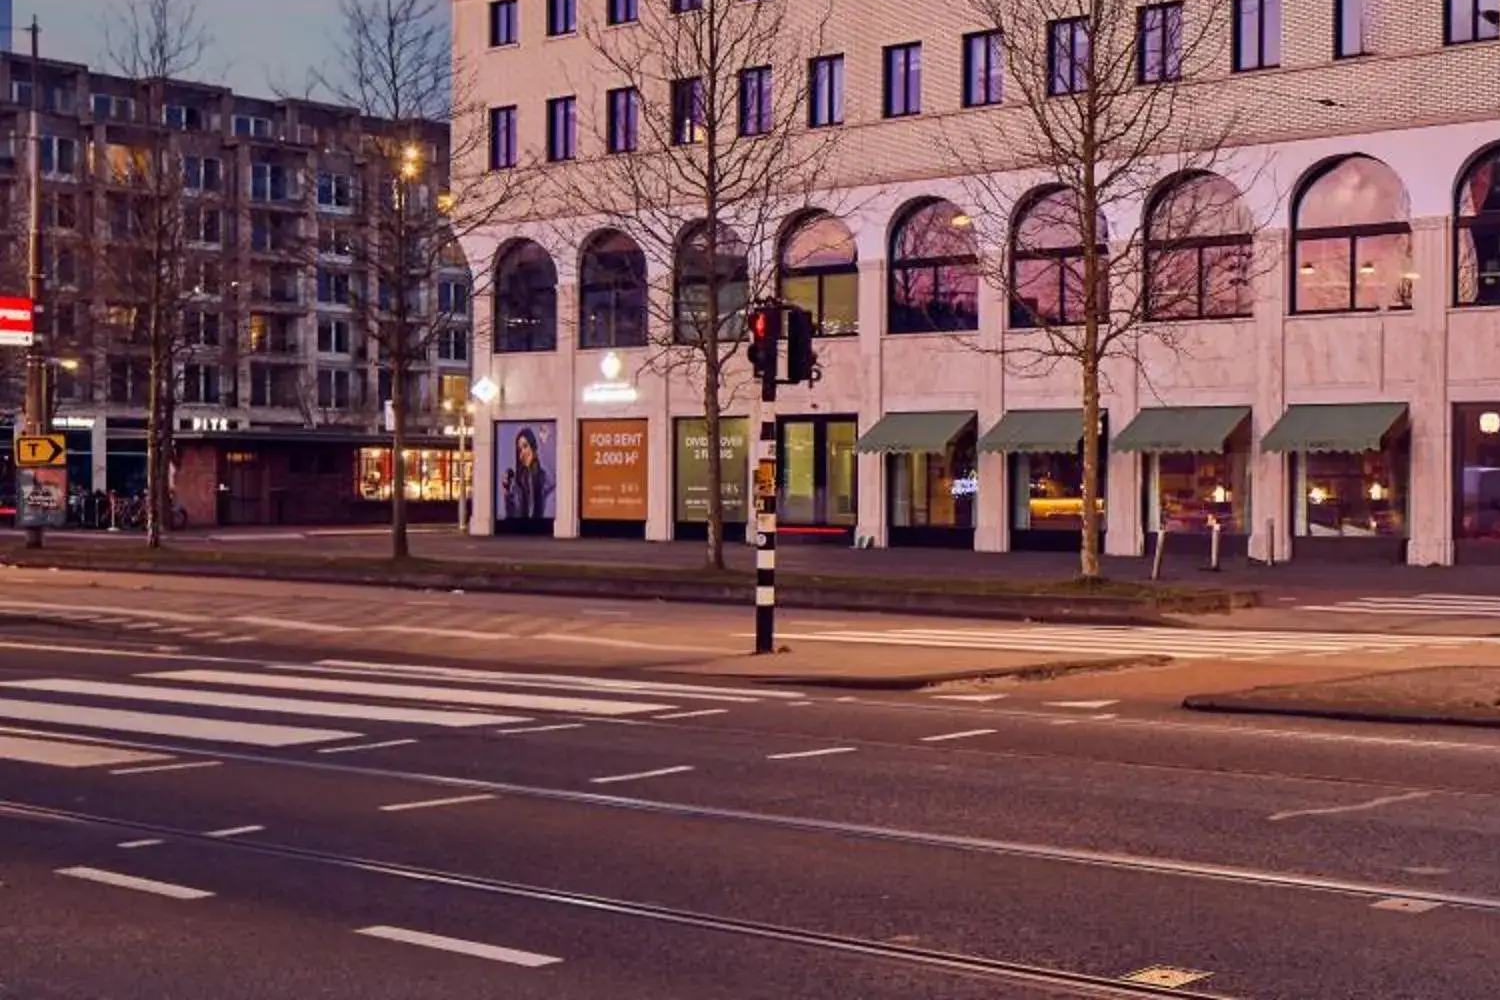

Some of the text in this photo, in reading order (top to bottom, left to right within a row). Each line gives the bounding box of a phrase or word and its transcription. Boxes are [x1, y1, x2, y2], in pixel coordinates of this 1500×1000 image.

[589, 433, 643, 447] FOR RENT
[27, 443, 40, 457] T
